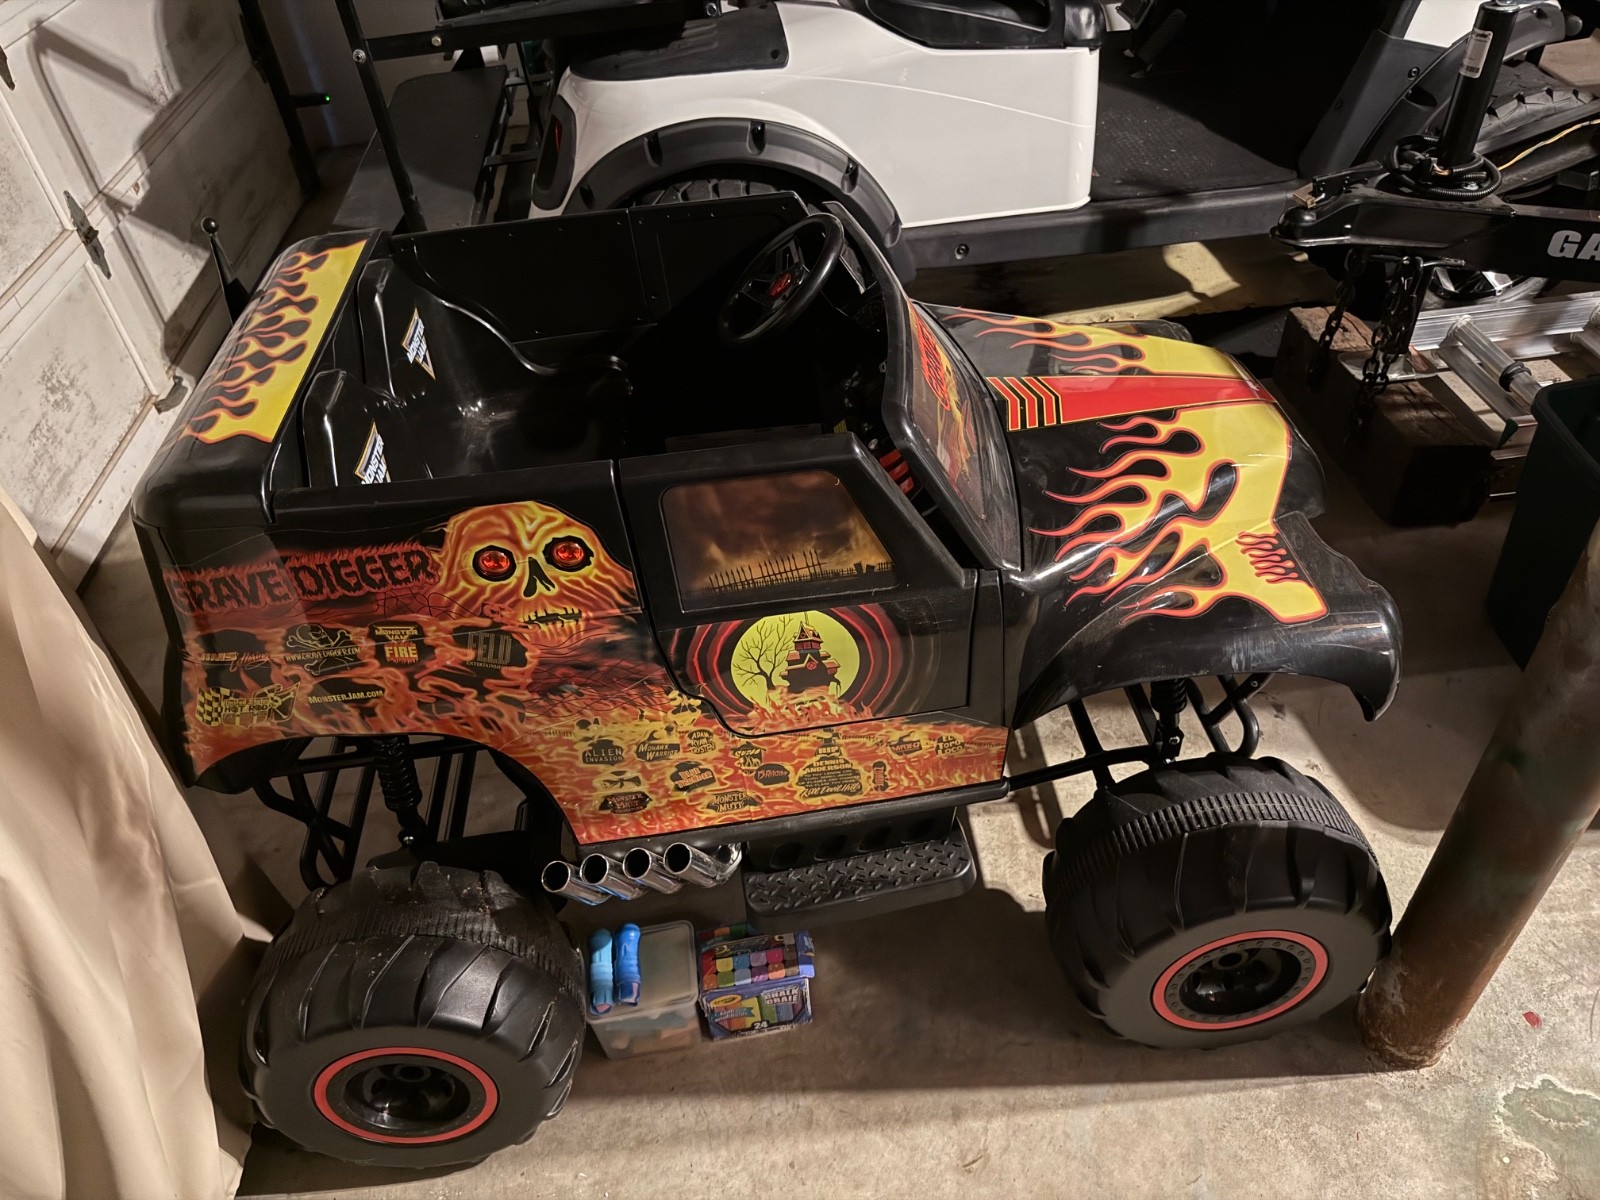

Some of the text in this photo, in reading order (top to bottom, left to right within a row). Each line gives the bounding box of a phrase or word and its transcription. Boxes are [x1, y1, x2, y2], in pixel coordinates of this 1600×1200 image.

[290, 549, 436, 597] DIGGER
[384, 645, 418, 659] FIRE
[468, 632, 513, 664] FELD
[585, 748, 622, 757] ALIEN
[753, 1021, 768, 1029] 24
